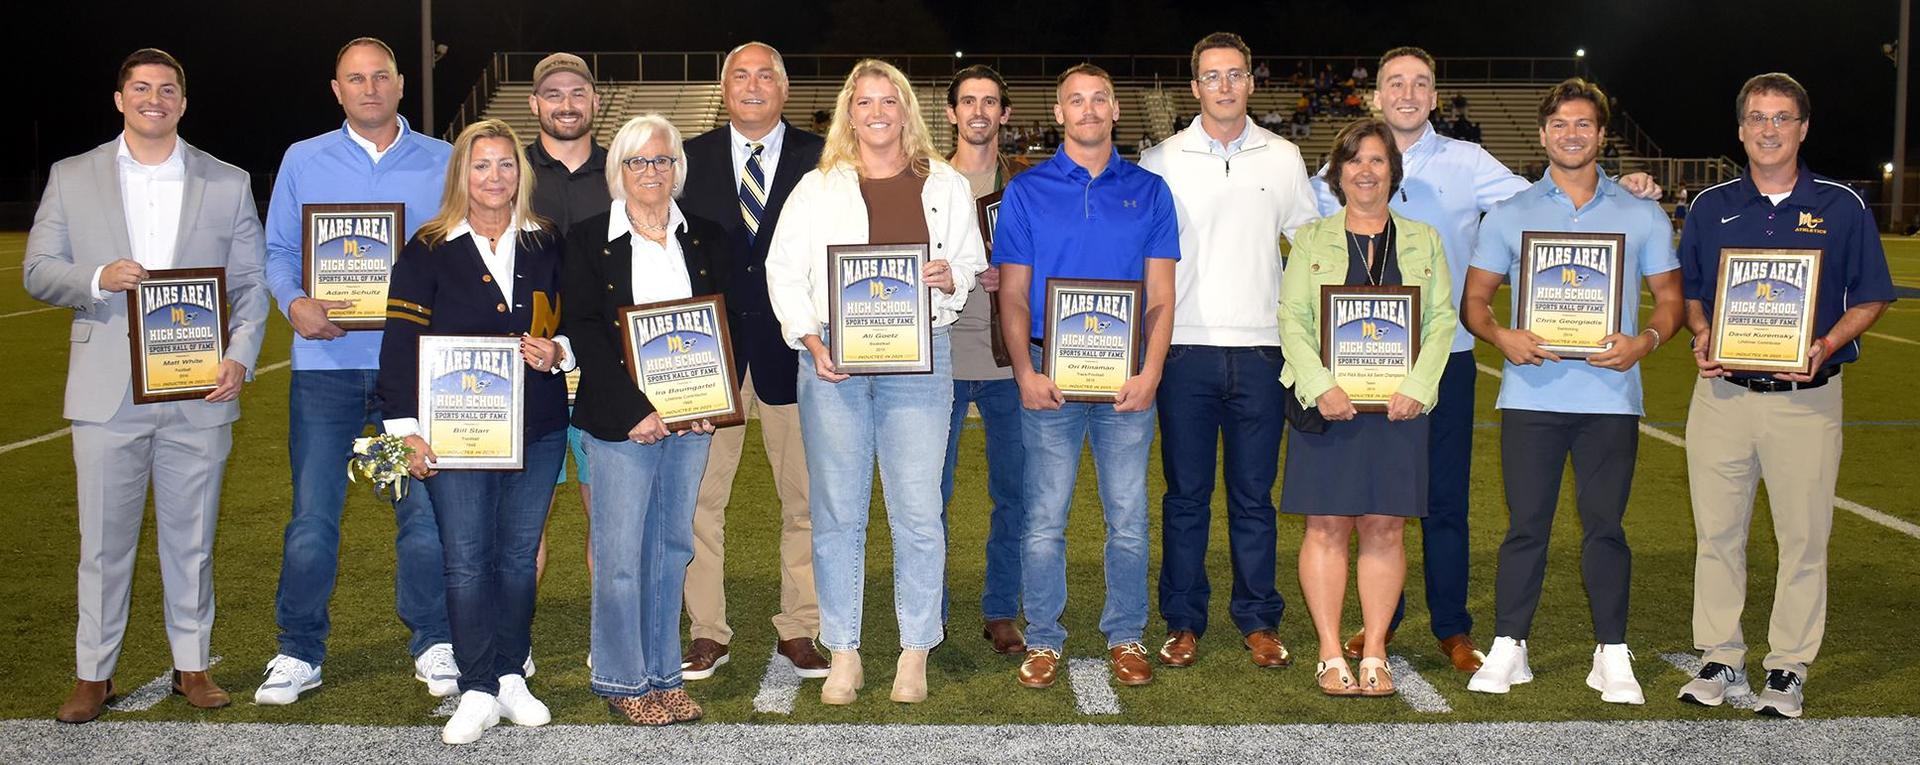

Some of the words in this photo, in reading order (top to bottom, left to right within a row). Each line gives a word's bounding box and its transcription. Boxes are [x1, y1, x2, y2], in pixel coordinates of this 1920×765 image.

[318, 218, 352, 244] MARS
[355, 218, 388, 244] AREA
[320, 260, 344, 270] HIGH
[348, 260, 386, 270] SCHOOL
[1537, 247, 1572, 273] MARS
[1574, 247, 1607, 275] AREA
[844, 260, 878, 287] MARS
[880, 259, 914, 286] AREA
[1732, 262, 1768, 288] MARS
[1769, 262, 1802, 288] AREA
[145, 286, 178, 315] MARS
[181, 284, 213, 312] AREA
[1537, 288, 1561, 298] HIGH
[1565, 288, 1604, 299] SCHOOL
[848, 301, 872, 312] HIGH
[875, 301, 912, 312] SCHOOL
[1061, 294, 1094, 320] MARS
[1096, 295, 1127, 322] AREA
[1337, 301, 1370, 327] MARS
[1373, 301, 1405, 328] AREA
[1731, 301, 1756, 312] HIGH
[1758, 302, 1798, 314] SCHOOL
[150, 329, 173, 340] HIGH
[177, 327, 213, 339] SCHOOL
[637, 314, 674, 346] MARS
[676, 310, 712, 336] AREA
[1062, 334, 1083, 345] HIGH
[1088, 335, 1123, 346] SCHOOL
[1340, 342, 1363, 352] HIGH
[1366, 342, 1403, 353] SCHOOL
[434, 351, 471, 379] MARS
[474, 351, 509, 380] AREA
[646, 357, 673, 371] HIGH
[675, 352, 716, 367] SCHOOL
[648, 374, 671, 382] SPORTS
[669, 383, 716, 394] Baumgartel
[438, 395, 464, 406] HIGH
[466, 395, 507, 406] SCHOOL
